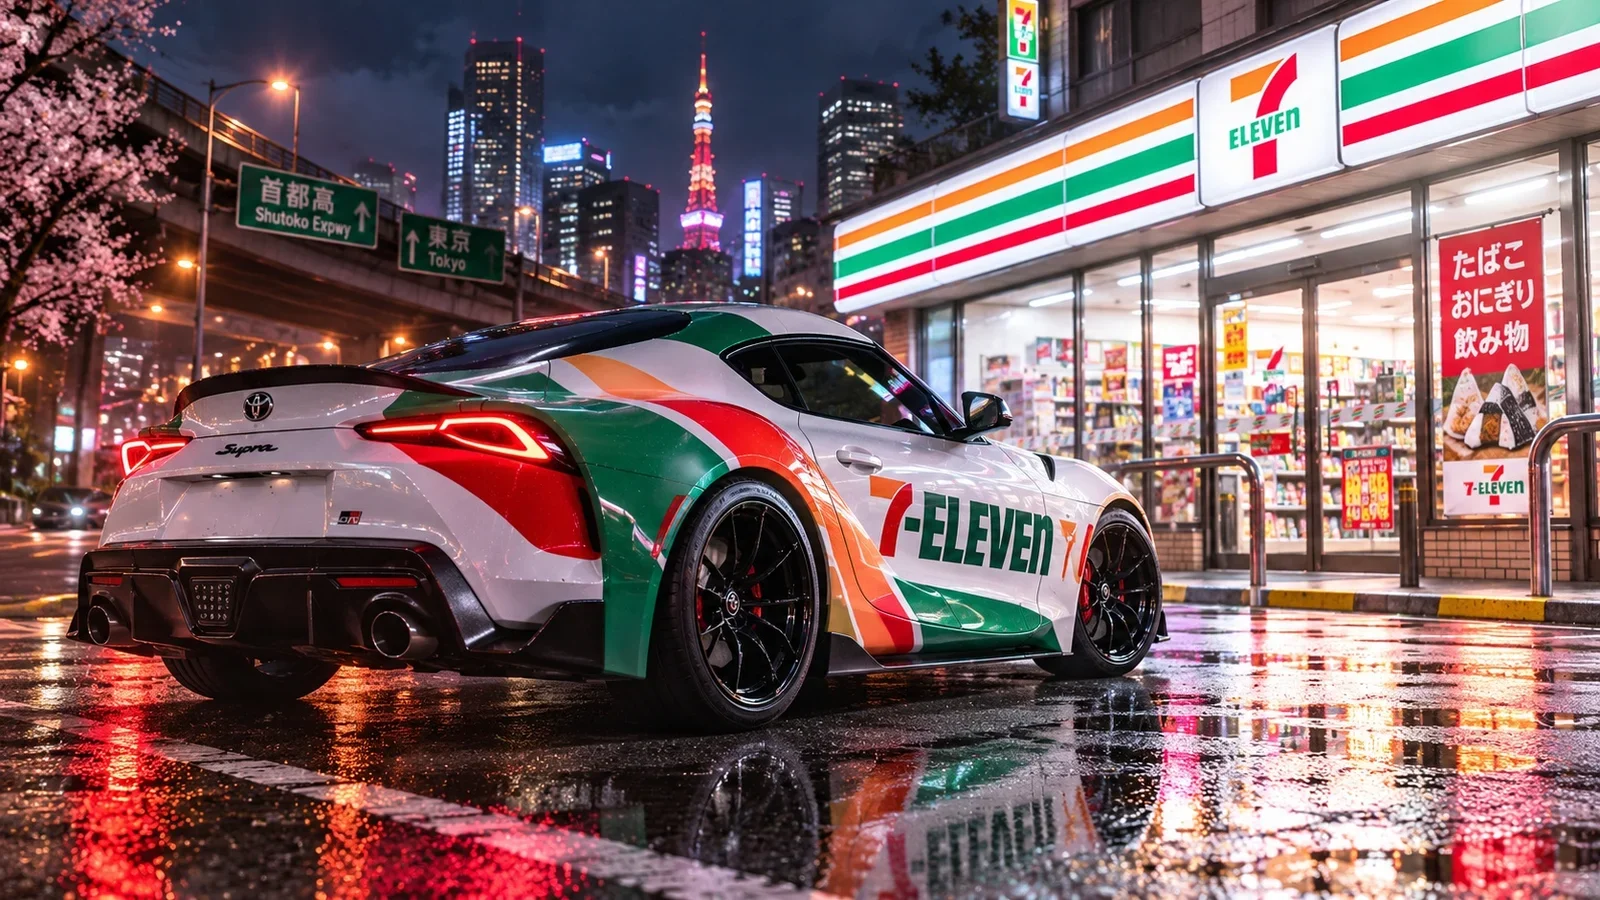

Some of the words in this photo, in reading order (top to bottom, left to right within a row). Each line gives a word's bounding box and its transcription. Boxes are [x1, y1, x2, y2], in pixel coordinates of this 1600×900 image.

[260, 176, 334, 214] 首都高
[255, 207, 309, 230] Shutoko
[312, 215, 351, 240] Expwy
[428, 224, 471, 254] 東京
[428, 251, 466, 273] Tokyo
[1453, 240, 1525, 280] たばこ
[1452, 279, 1534, 319] おにぎり
[1454, 321, 1529, 359] 飲み物
[215, 443, 278, 458] Supra
